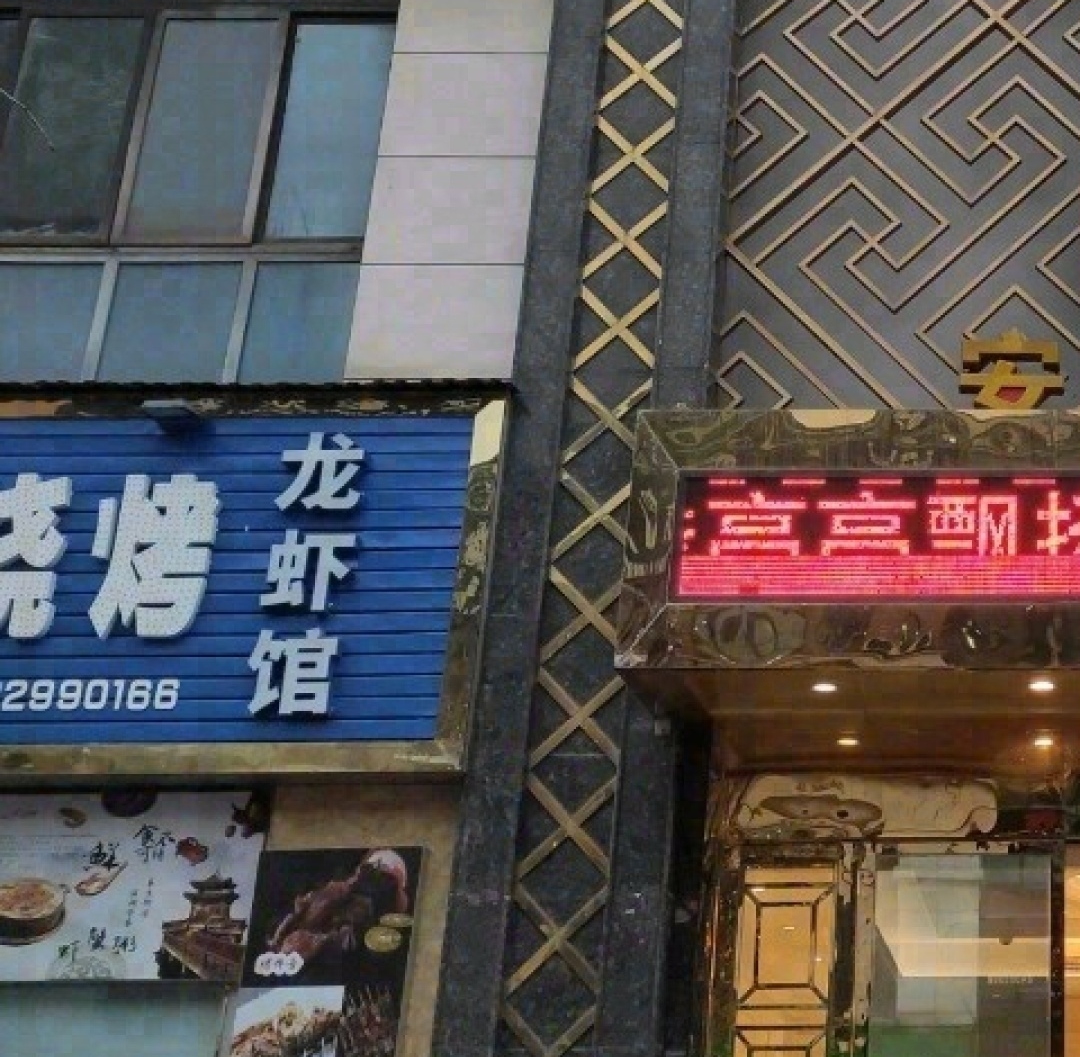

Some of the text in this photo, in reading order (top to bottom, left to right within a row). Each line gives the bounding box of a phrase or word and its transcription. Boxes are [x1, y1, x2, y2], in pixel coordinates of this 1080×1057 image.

[247, 432, 364, 715] 龙虾馆
[0, 678, 180, 711] 2990166
